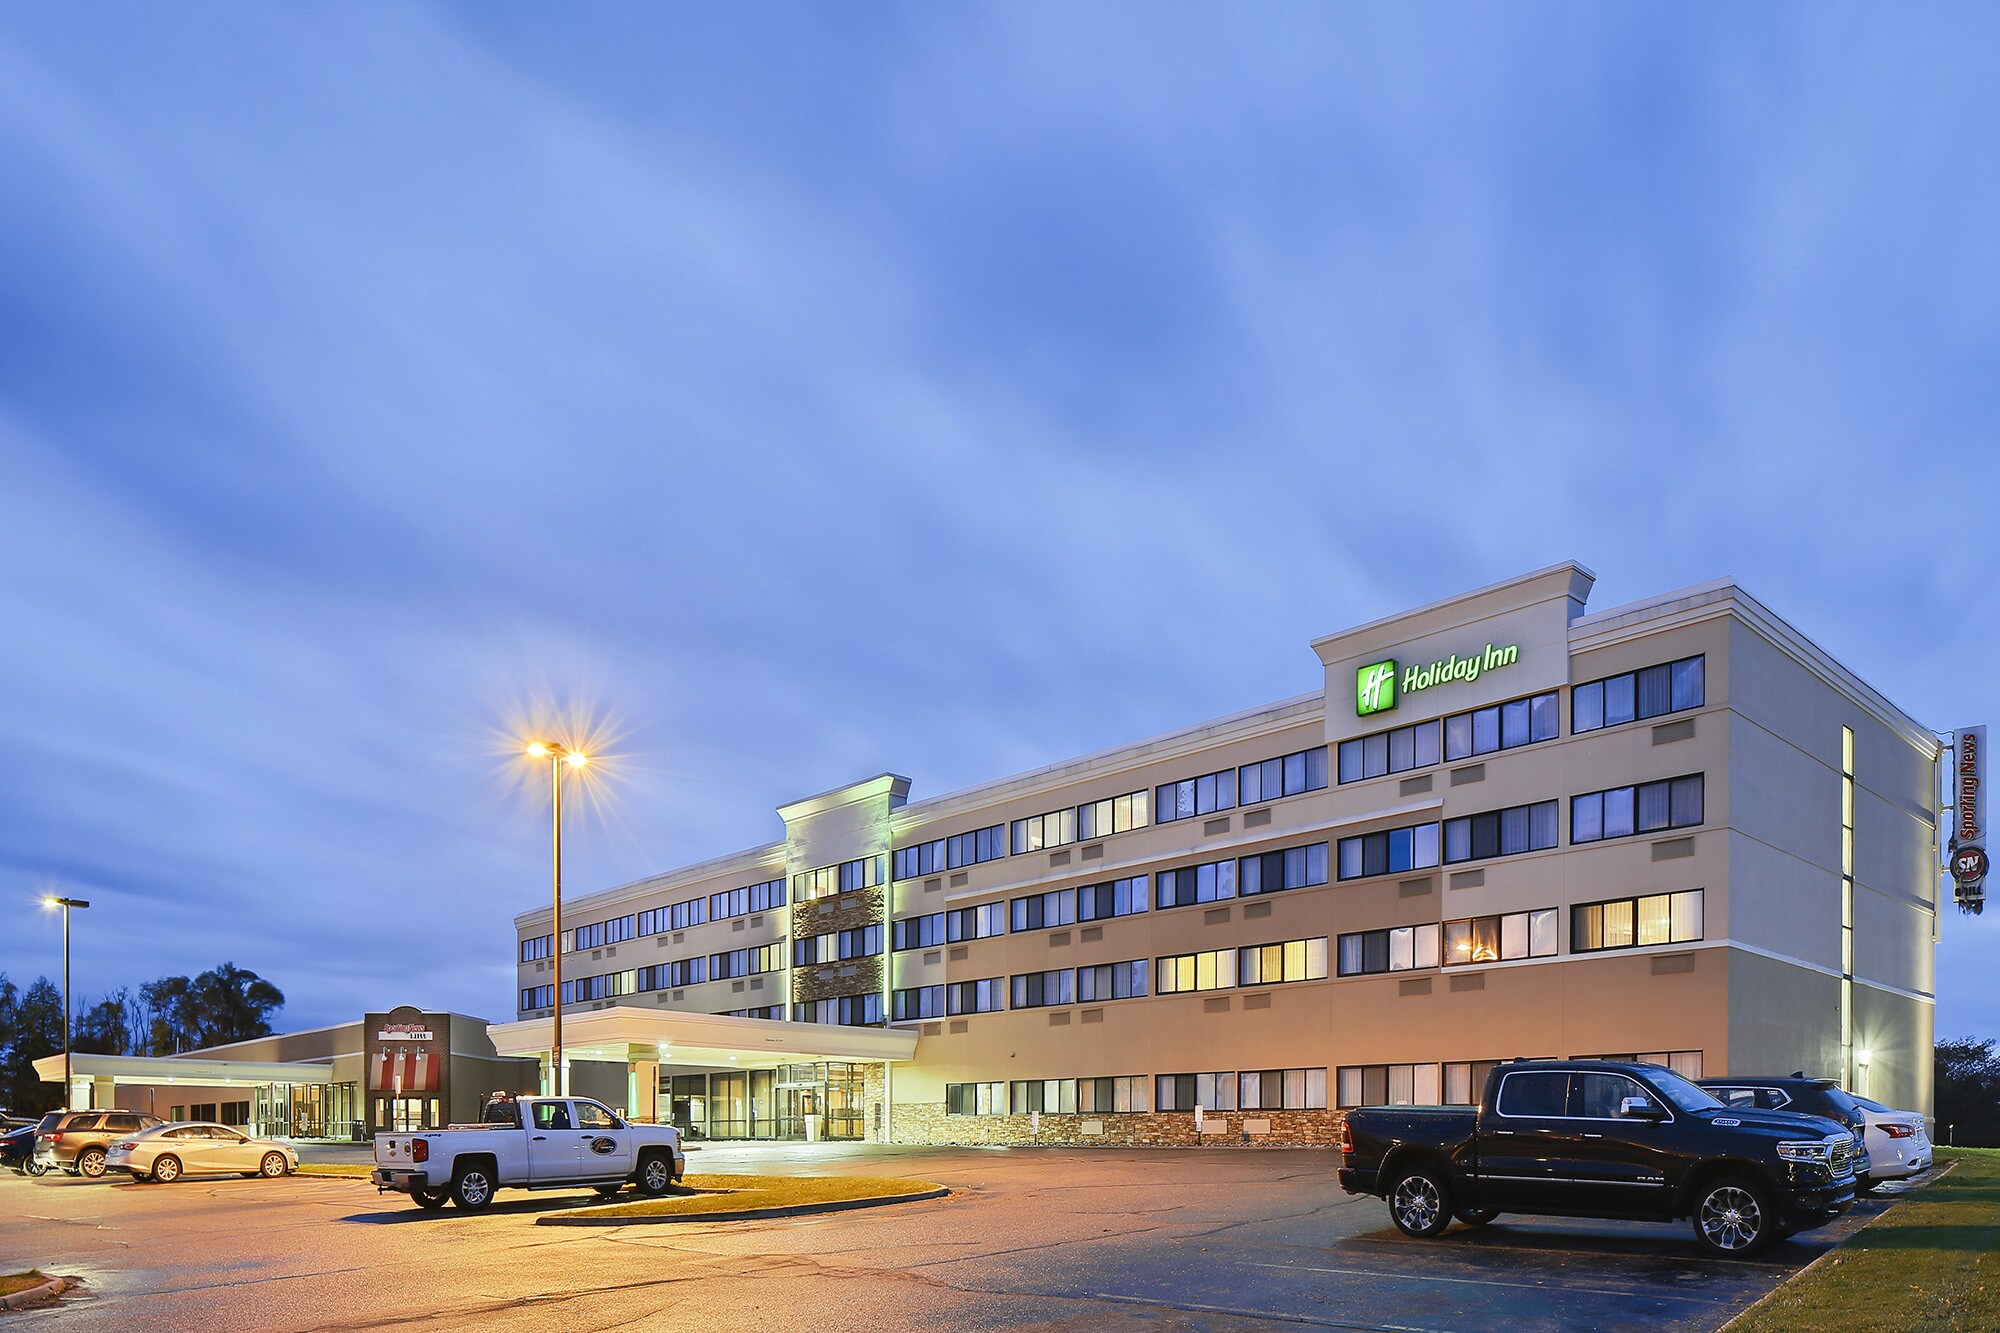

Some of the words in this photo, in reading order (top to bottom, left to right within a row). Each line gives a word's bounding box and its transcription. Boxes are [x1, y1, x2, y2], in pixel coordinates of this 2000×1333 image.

[1401, 654, 1482, 694] Holiday
[1483, 643, 1519, 672] Inn
[1960, 733, 1976, 774] News
[1960, 776, 1980, 839] Sporting
